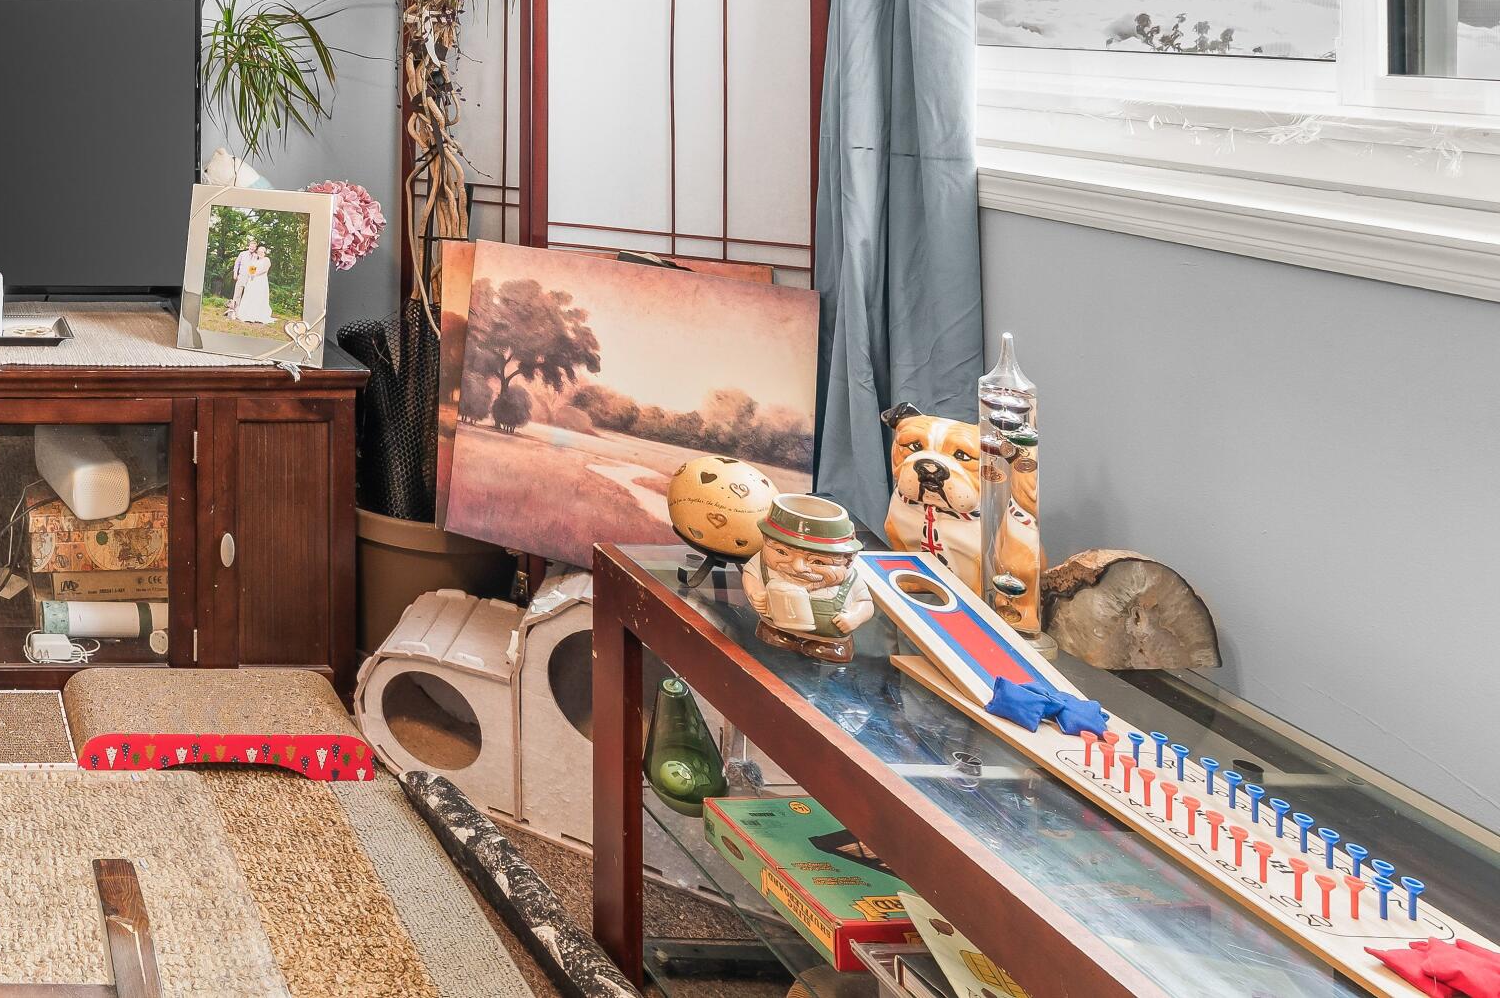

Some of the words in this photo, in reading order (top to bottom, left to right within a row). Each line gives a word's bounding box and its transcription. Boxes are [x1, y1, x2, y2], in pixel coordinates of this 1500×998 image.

[1083, 769, 1102, 780] 2
[1102, 783, 1122, 794] 3
[1128, 797, 1143, 808] 4
[1146, 812, 1165, 824] 5
[1169, 827, 1189, 839] 6
[1189, 843, 1207, 855] 7
[1215, 859, 1237, 872] 8
[1240, 876, 1263, 890] 9
[1269, 894, 1302, 908] 10
[1296, 913, 1333, 928] 20
[767, 872, 832, 939] SHUFFLEBOARD
